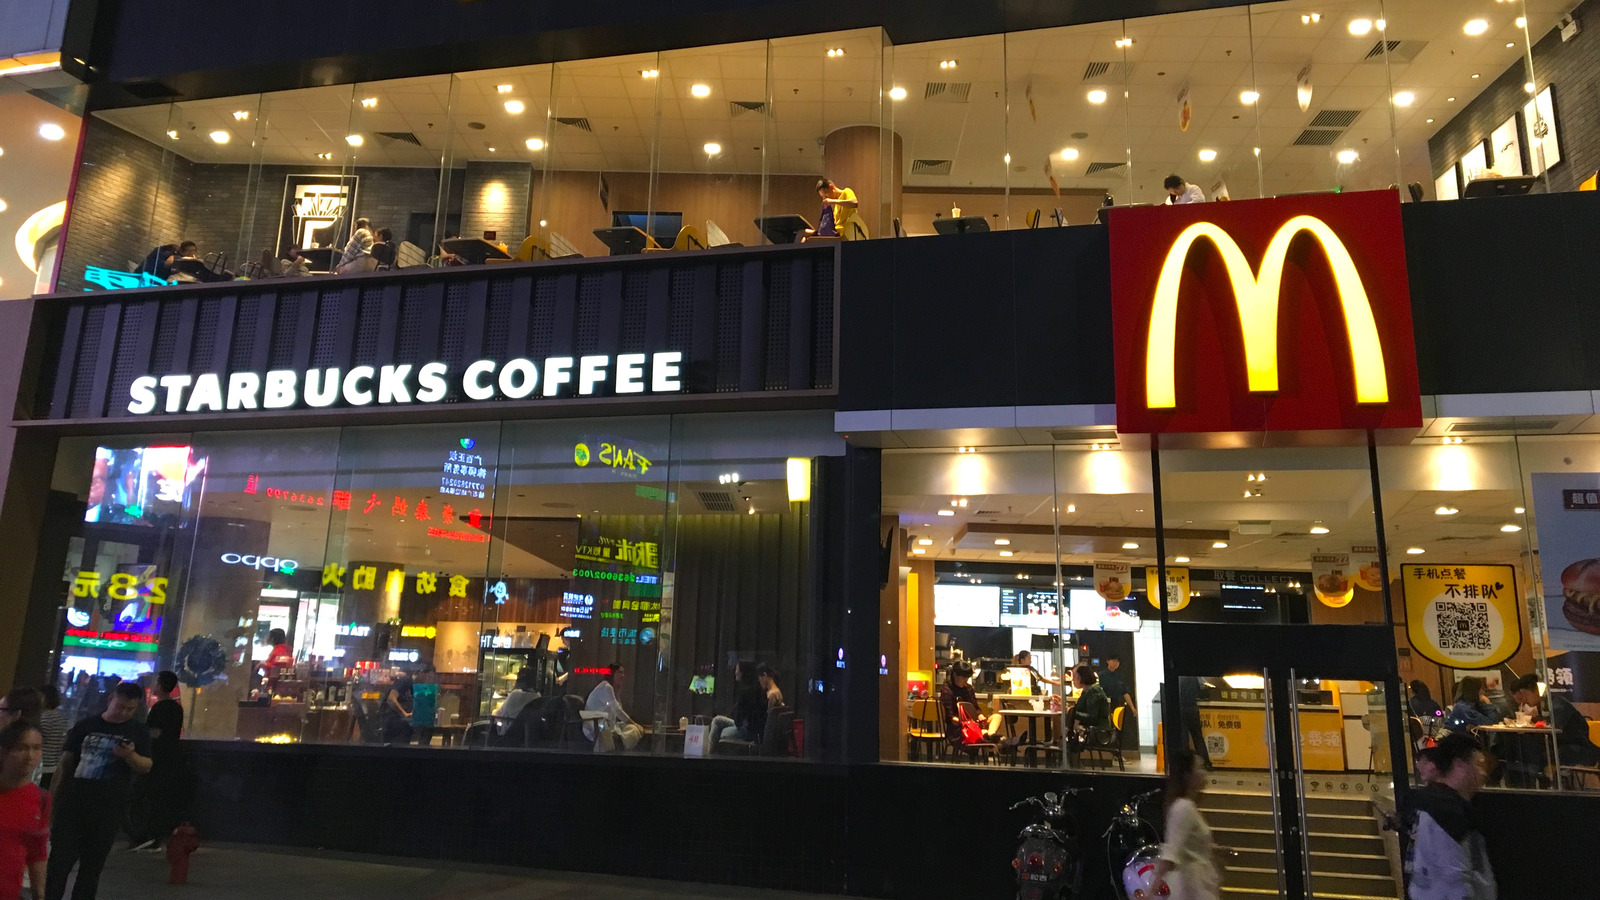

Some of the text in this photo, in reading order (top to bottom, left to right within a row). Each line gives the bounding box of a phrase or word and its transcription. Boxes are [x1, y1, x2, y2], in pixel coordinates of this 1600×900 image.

[127, 351, 683, 415] STARBUCKS COFFEE
[1572, 492, 1599, 504] 超值
[1213, 570, 1236, 581] 取餐
[1240, 574, 1294, 583] COLLECT
[1413, 567, 1467, 580] 手机点餐
[1444, 583, 1499, 600] 不排队
